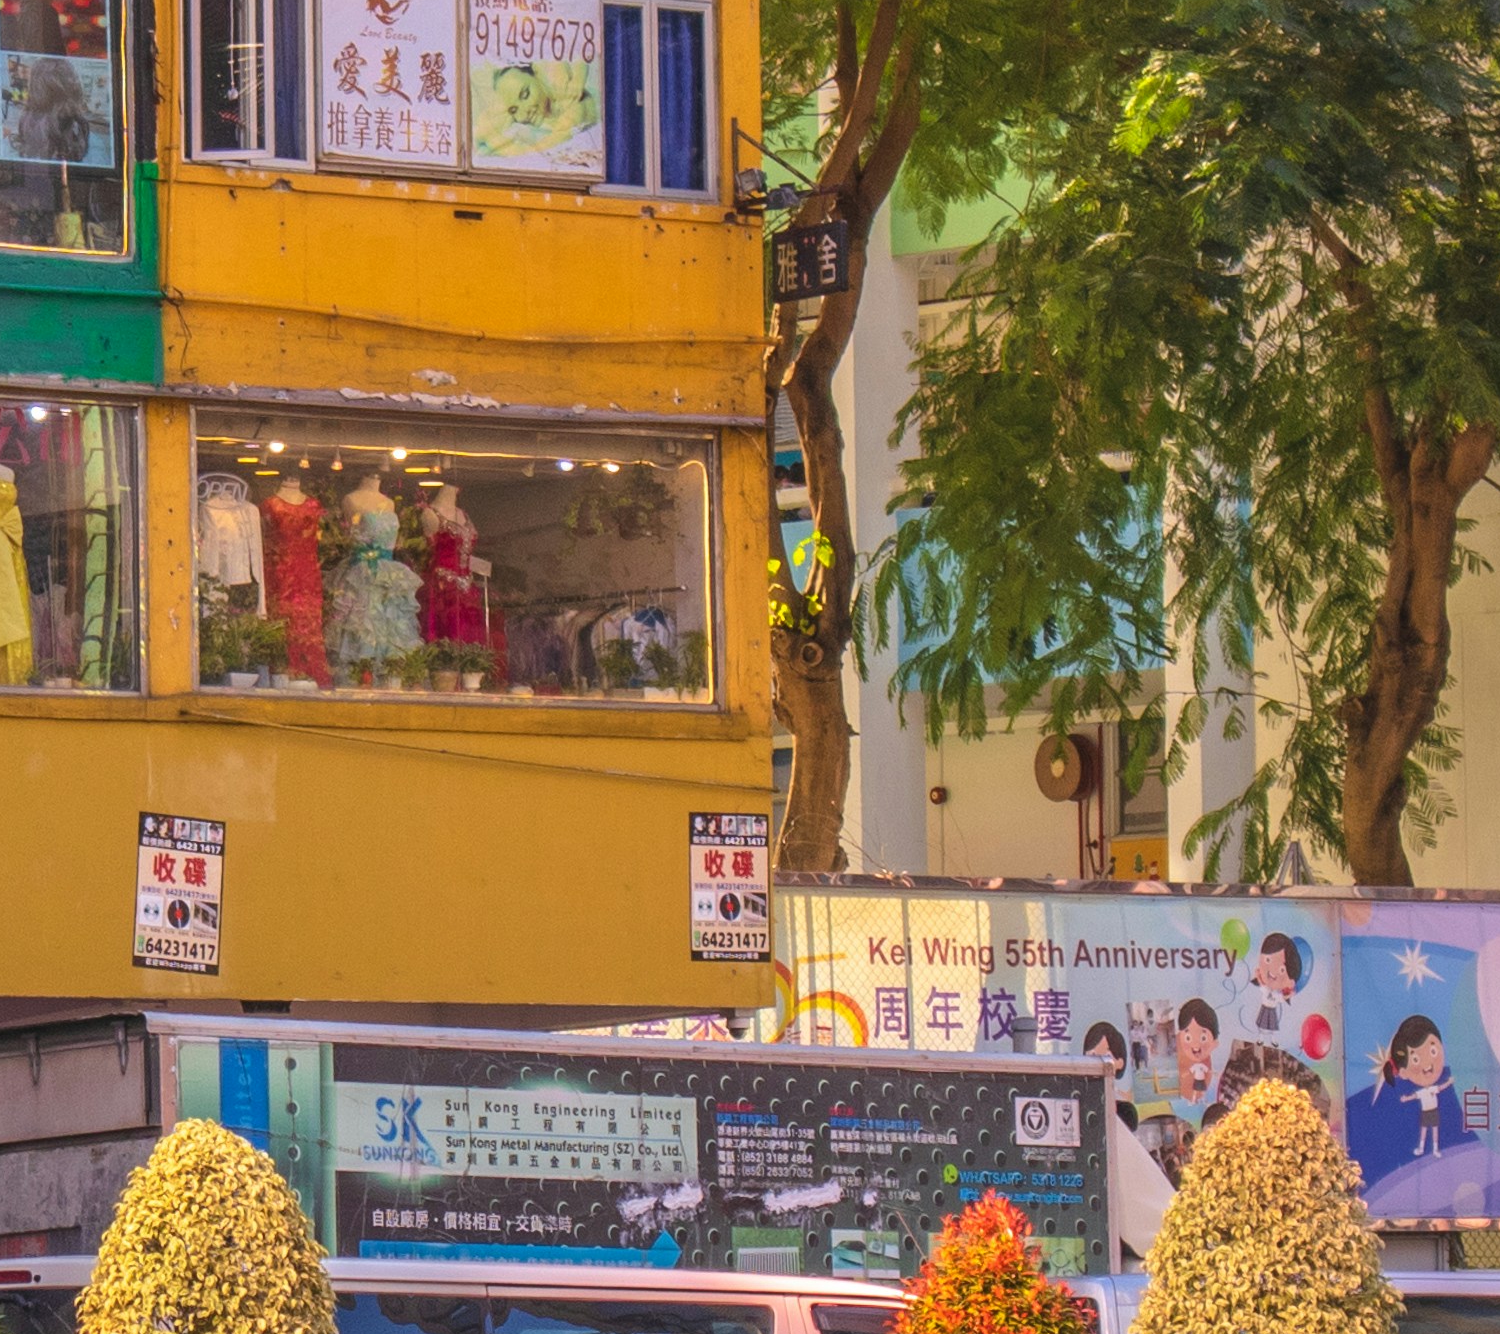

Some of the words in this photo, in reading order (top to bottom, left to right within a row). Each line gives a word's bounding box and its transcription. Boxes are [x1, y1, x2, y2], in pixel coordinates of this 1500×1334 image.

[475, 12, 596, 64] 91497678
[333, 42, 451, 105] 愛美麗
[176, 841, 198, 852] 6423
[201, 844, 222, 854] 1417
[725, 836, 745, 846] 6423
[747, 837, 766, 846] 1417
[145, 937, 216, 961] 64231417
[702, 932, 767, 948] 64231417
[868, 937, 914, 967] Kei
[924, 938, 995, 973] Wing
[1005, 938, 1064, 968] 55th
[1073, 938, 1237, 976] Anniversary
[874, 986, 1074, 1043] 周年校慶
[445, 1099, 469, 1112] Sun
[485, 1101, 518, 1116] Kong
[534, 1102, 616, 1119] Engineering
[631, 1107, 682, 1121] Limited
[446, 1136, 466, 1149] Sun
[470, 1137, 498, 1151] Kong
[501, 1139, 531, 1151] Metal
[534, 1140, 609, 1156] Manufacturing
